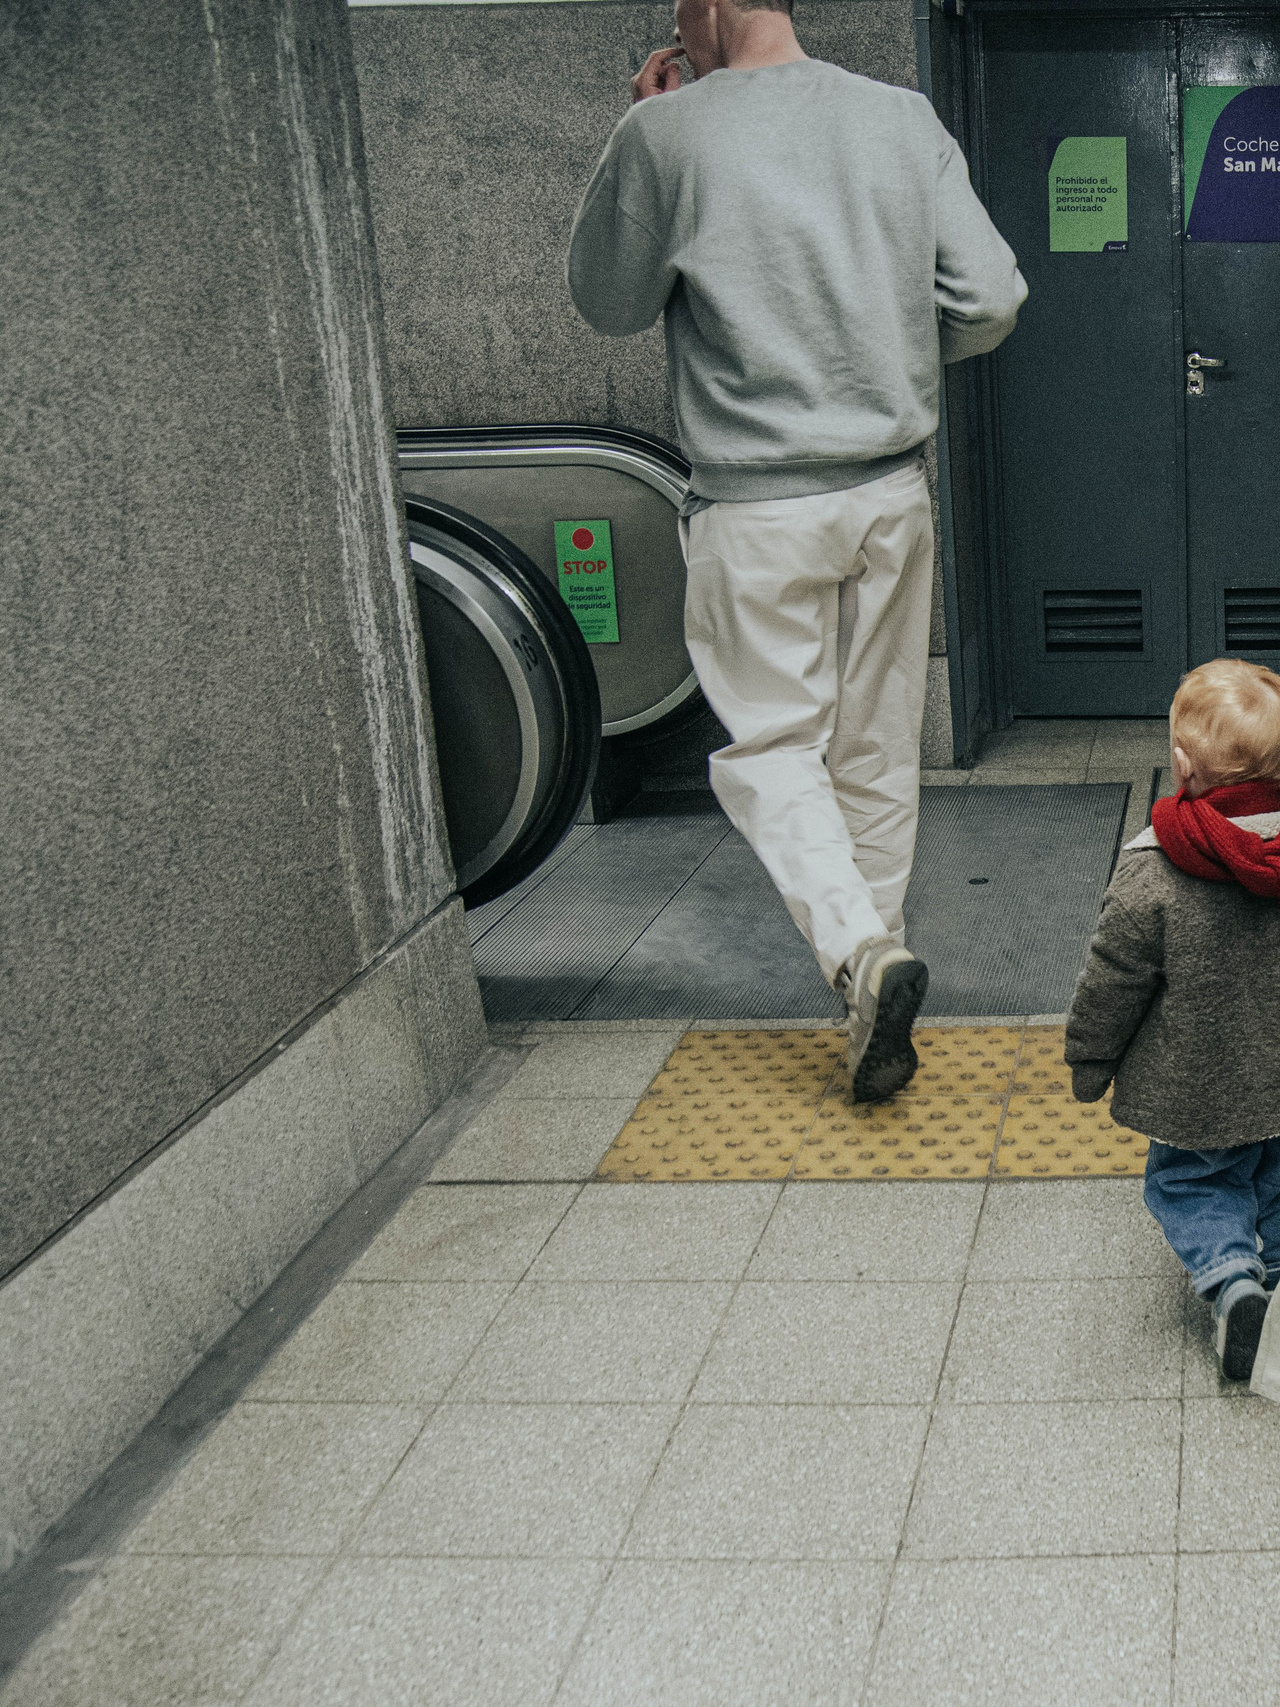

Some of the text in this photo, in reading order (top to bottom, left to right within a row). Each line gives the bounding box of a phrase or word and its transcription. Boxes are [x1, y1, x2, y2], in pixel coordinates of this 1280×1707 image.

[1223, 157, 1256, 172] San
[1055, 176, 1108, 185] Prohibido el
[1055, 186, 1088, 195] ingreso
[1056, 195, 1093, 204] personal
[1056, 204, 1103, 212] autorizado
[563, 560, 607, 575] STOP
[569, 585, 584, 593] Este
[568, 593, 607, 602] dispositivo
[576, 601, 611, 610] seguridad
